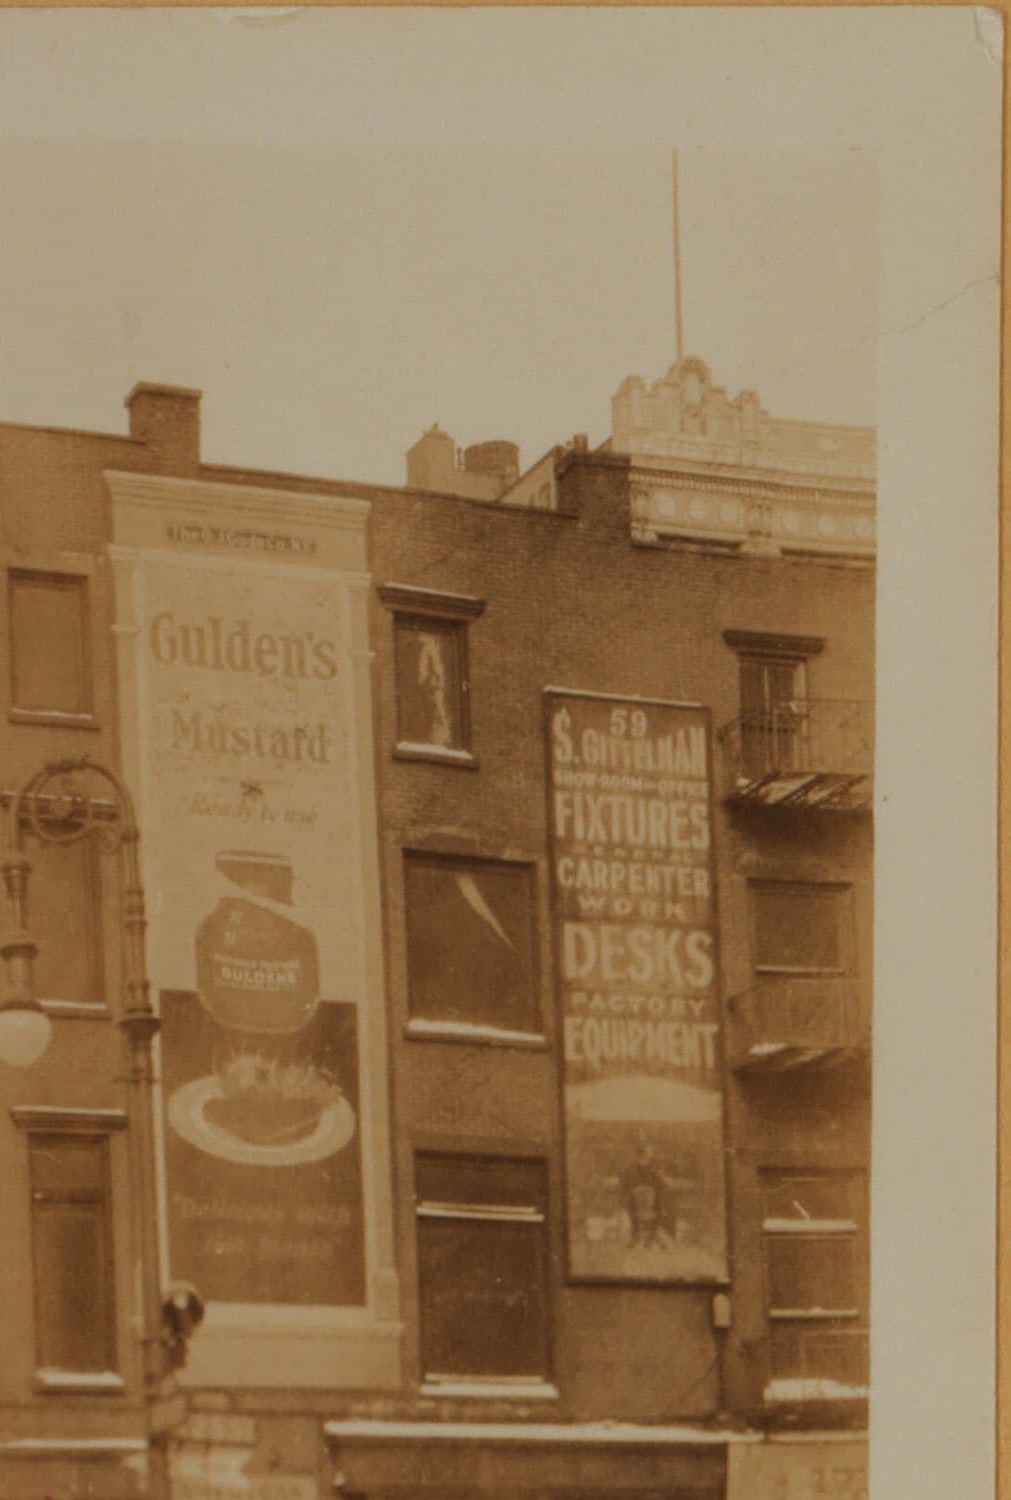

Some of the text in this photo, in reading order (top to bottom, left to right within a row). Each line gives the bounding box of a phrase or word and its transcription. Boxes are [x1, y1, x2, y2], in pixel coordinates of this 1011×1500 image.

[149, 612, 338, 681] Gulden's
[170, 708, 330, 764] Mustard
[610, 709, 648, 737] 59
[555, 790, 710, 849] FIXTURES
[557, 857, 710, 898] CARPENTER
[577, 894, 686, 921] WORK
[563, 922, 713, 988] DESKS
[571, 991, 705, 1016] FACTORY
[564, 1016, 718, 1069] EQUIPMENT
